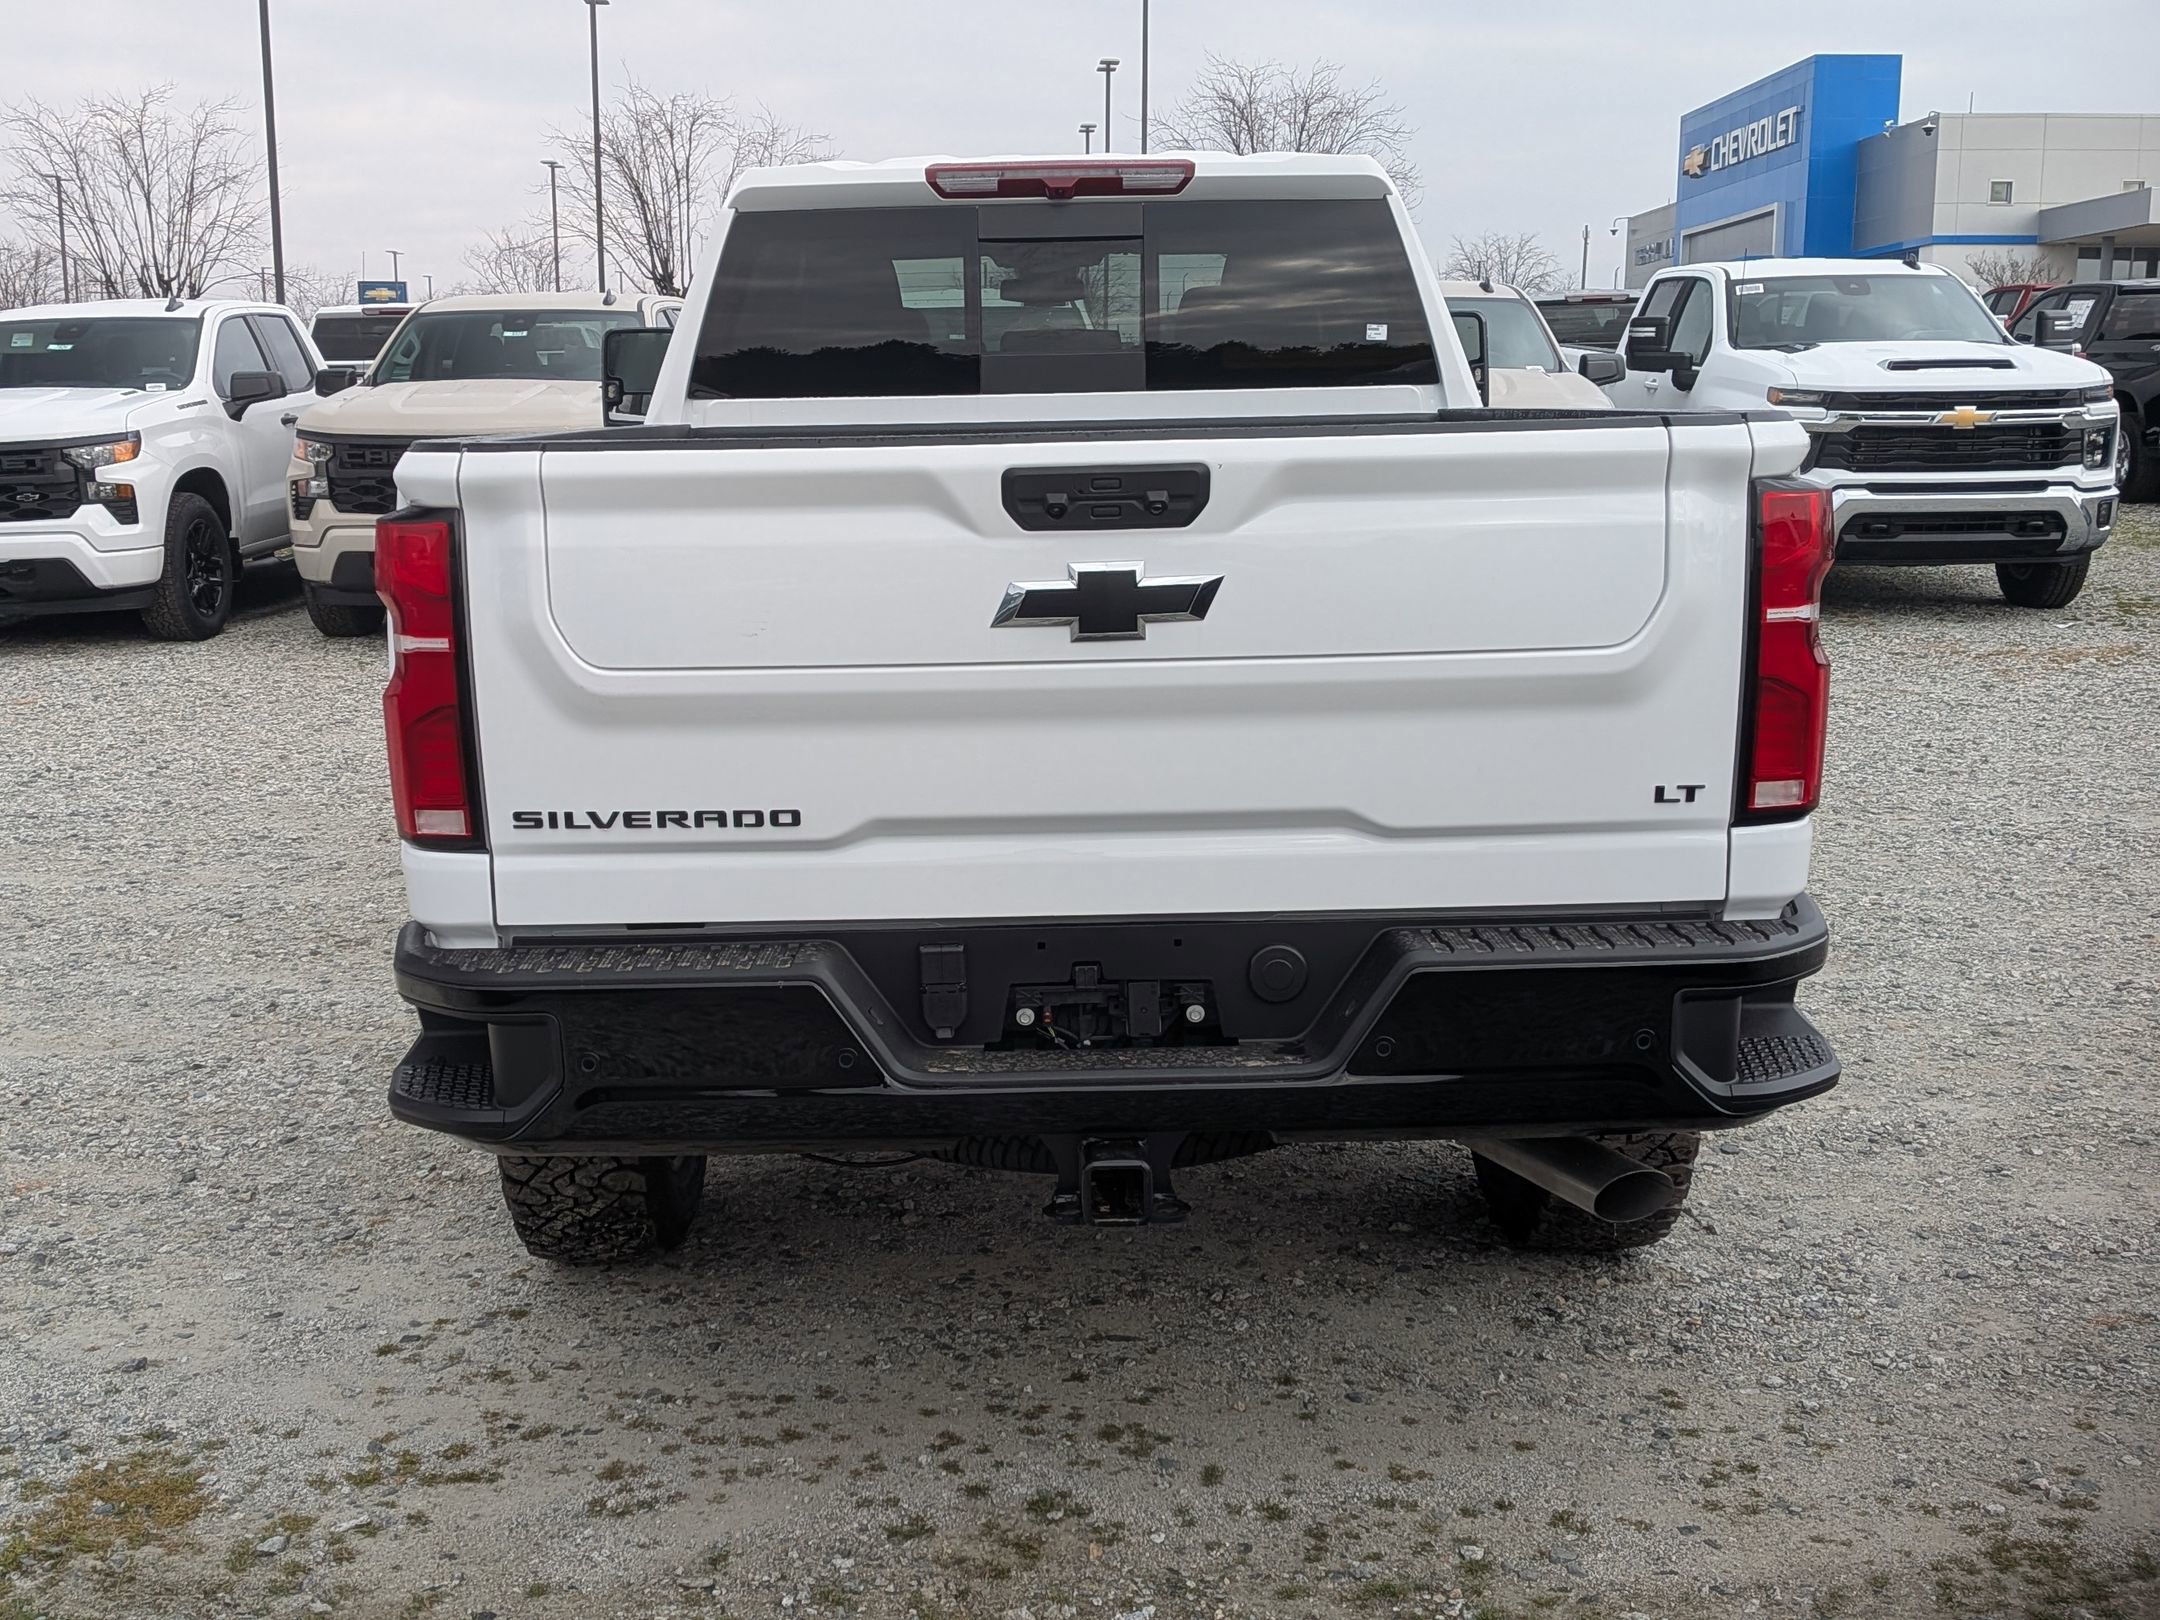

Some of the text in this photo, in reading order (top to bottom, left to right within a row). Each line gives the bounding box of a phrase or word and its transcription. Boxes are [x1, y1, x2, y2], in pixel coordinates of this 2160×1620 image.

[1711, 105, 1798, 171] CHEVROLET
[1654, 784, 1706, 804] LT
[512, 809, 801, 829] SILVERADO
